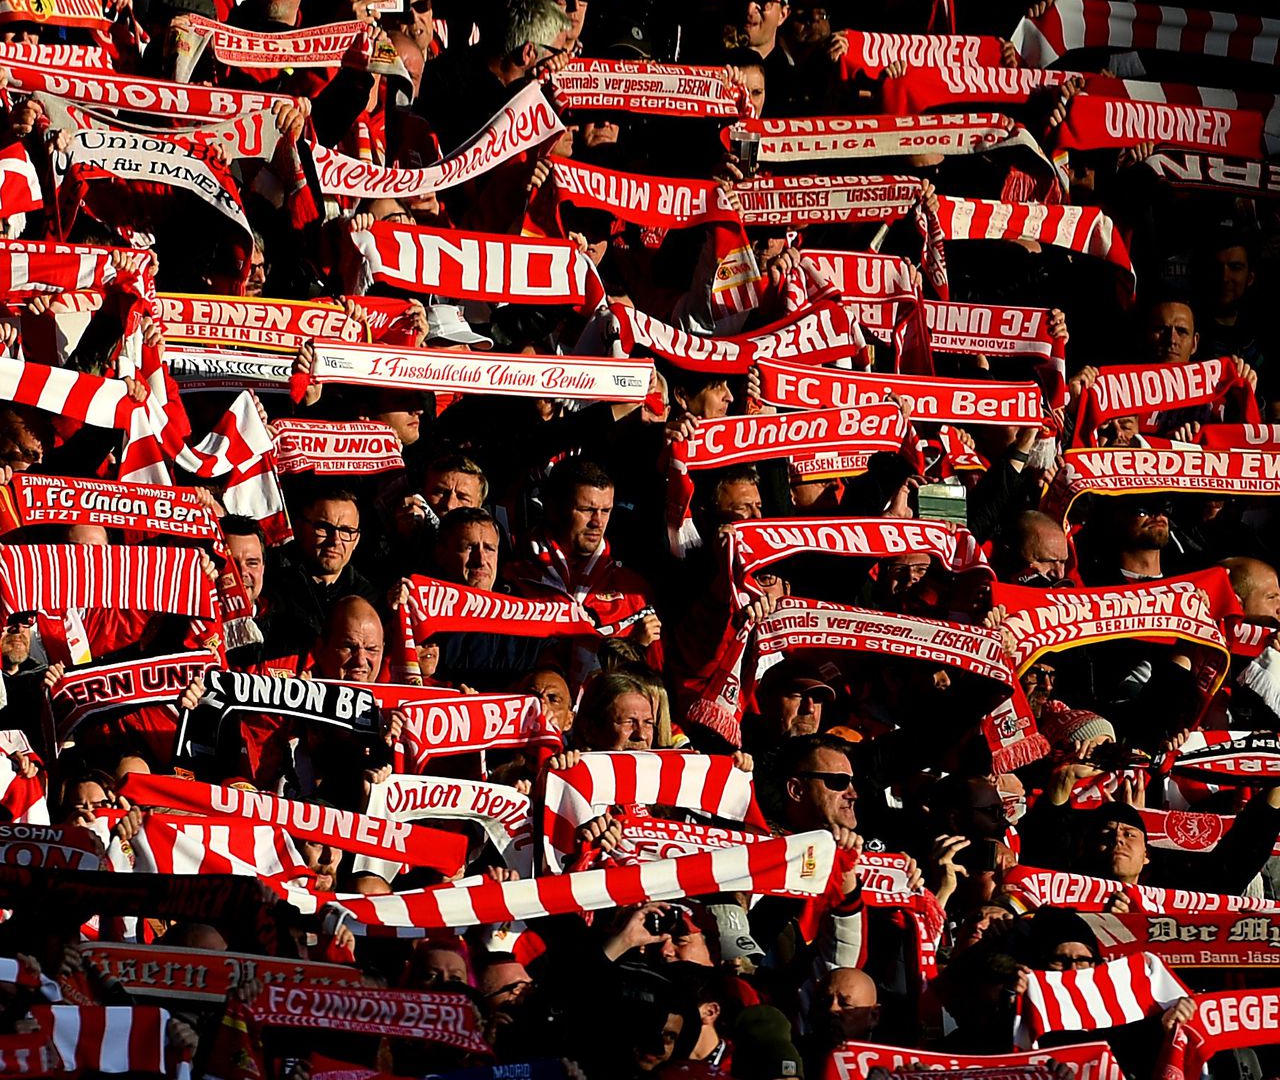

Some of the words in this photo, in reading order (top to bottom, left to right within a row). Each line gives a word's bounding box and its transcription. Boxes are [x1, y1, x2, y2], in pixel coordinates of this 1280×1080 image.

[861, 34, 981, 68] UNIONER
[40, 74, 189, 112] UNION
[630, 98, 685, 112] sterben
[1104, 101, 1231, 148] UNIONER
[898, 134, 951, 148] 2006
[114, 159, 144, 174] für
[189, 300, 292, 325] EINEN
[185, 324, 250, 339] BERLIN
[258, 328, 285, 342] IST
[634, 320, 740, 360] UNION
[371, 356, 384, 376] 1.
[385, 360, 482, 385] Fussballclub
[488, 366, 539, 389] Union
[542, 368, 598, 390] Berlin
[1092, 360, 1222, 410] UNIONER
[776, 375, 838, 402] FC
[689, 425, 735, 455] FC
[739, 410, 840, 448] Union
[334, 438, 399, 456] UNION
[1082, 452, 1228, 478] WERDEN
[22, 478, 70, 490] EINMAL
[74, 482, 128, 494] UNIONER
[1185, 480, 1230, 490] EISERN
[22, 488, 45, 508] 1.
[48, 488, 78, 509] FC
[84, 492, 148, 514] Union
[760, 525, 868, 551] UNION
[1095, 621, 1145, 632] BERLIN
[1151, 620, 1170, 630] IST
[865, 638, 942, 662] sterben
[931, 631, 985, 655] EISERN
[234, 678, 328, 712] UNION
[388, 785, 461, 812] Union
[210, 785, 411, 854] UNIONER
[5, 825, 64, 841] SOHN
[1148, 920, 1215, 941] Der
